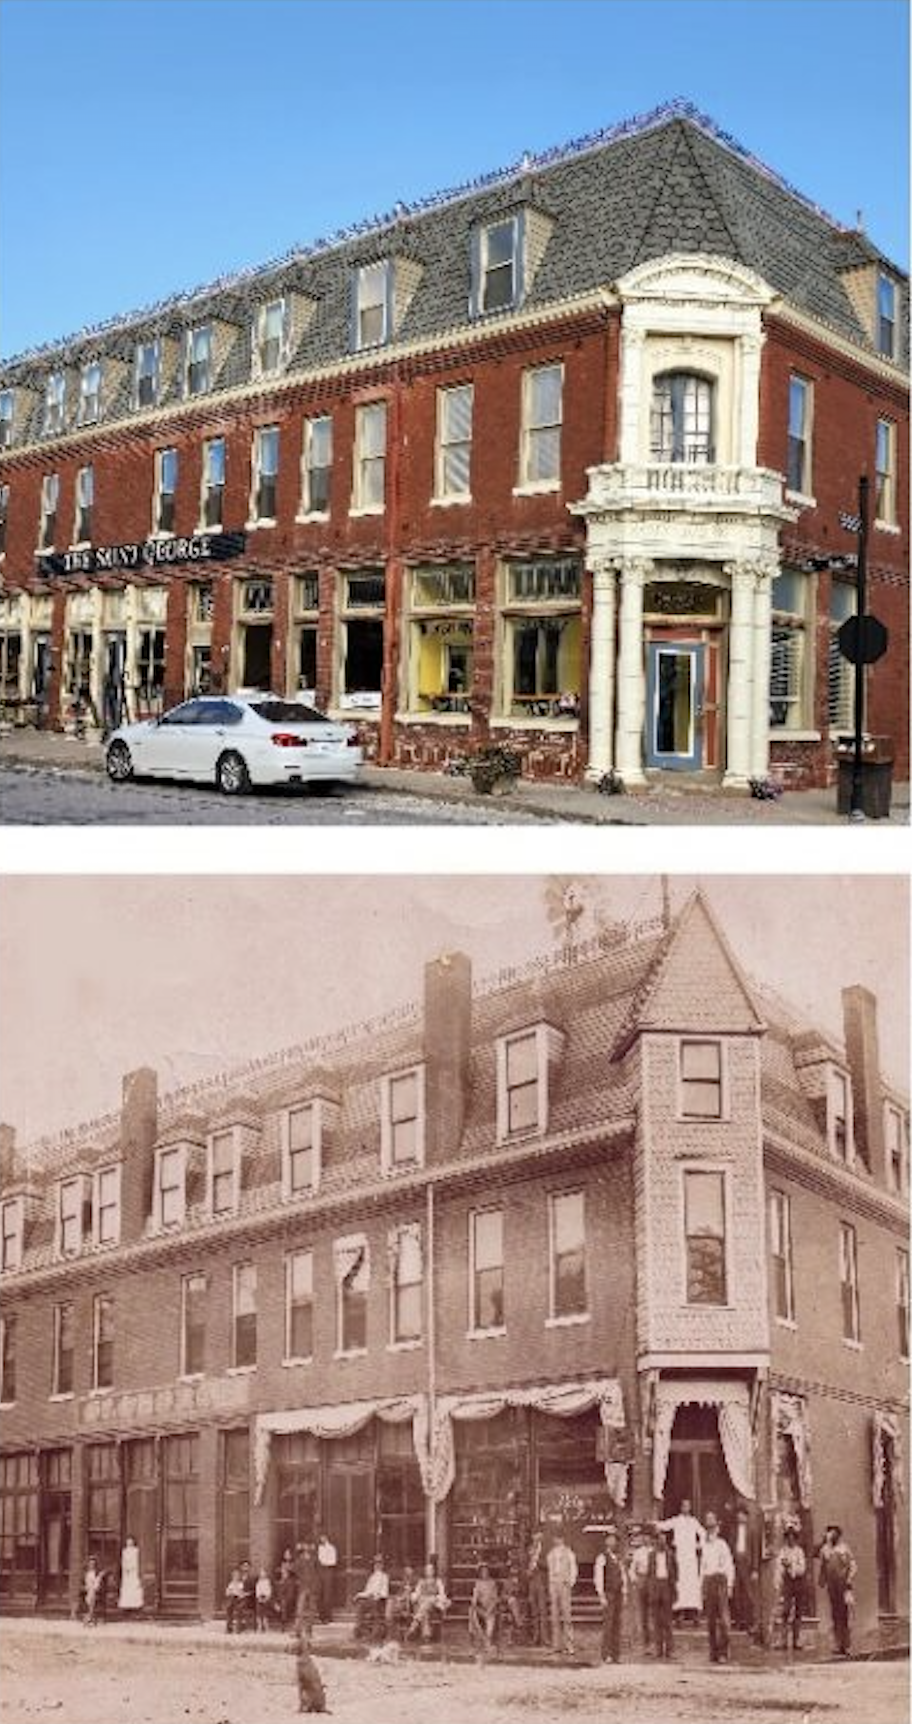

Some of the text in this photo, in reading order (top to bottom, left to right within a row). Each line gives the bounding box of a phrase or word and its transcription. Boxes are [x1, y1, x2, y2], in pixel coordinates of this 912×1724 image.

[64, 537, 211, 571] THE SAINT GEORGE
